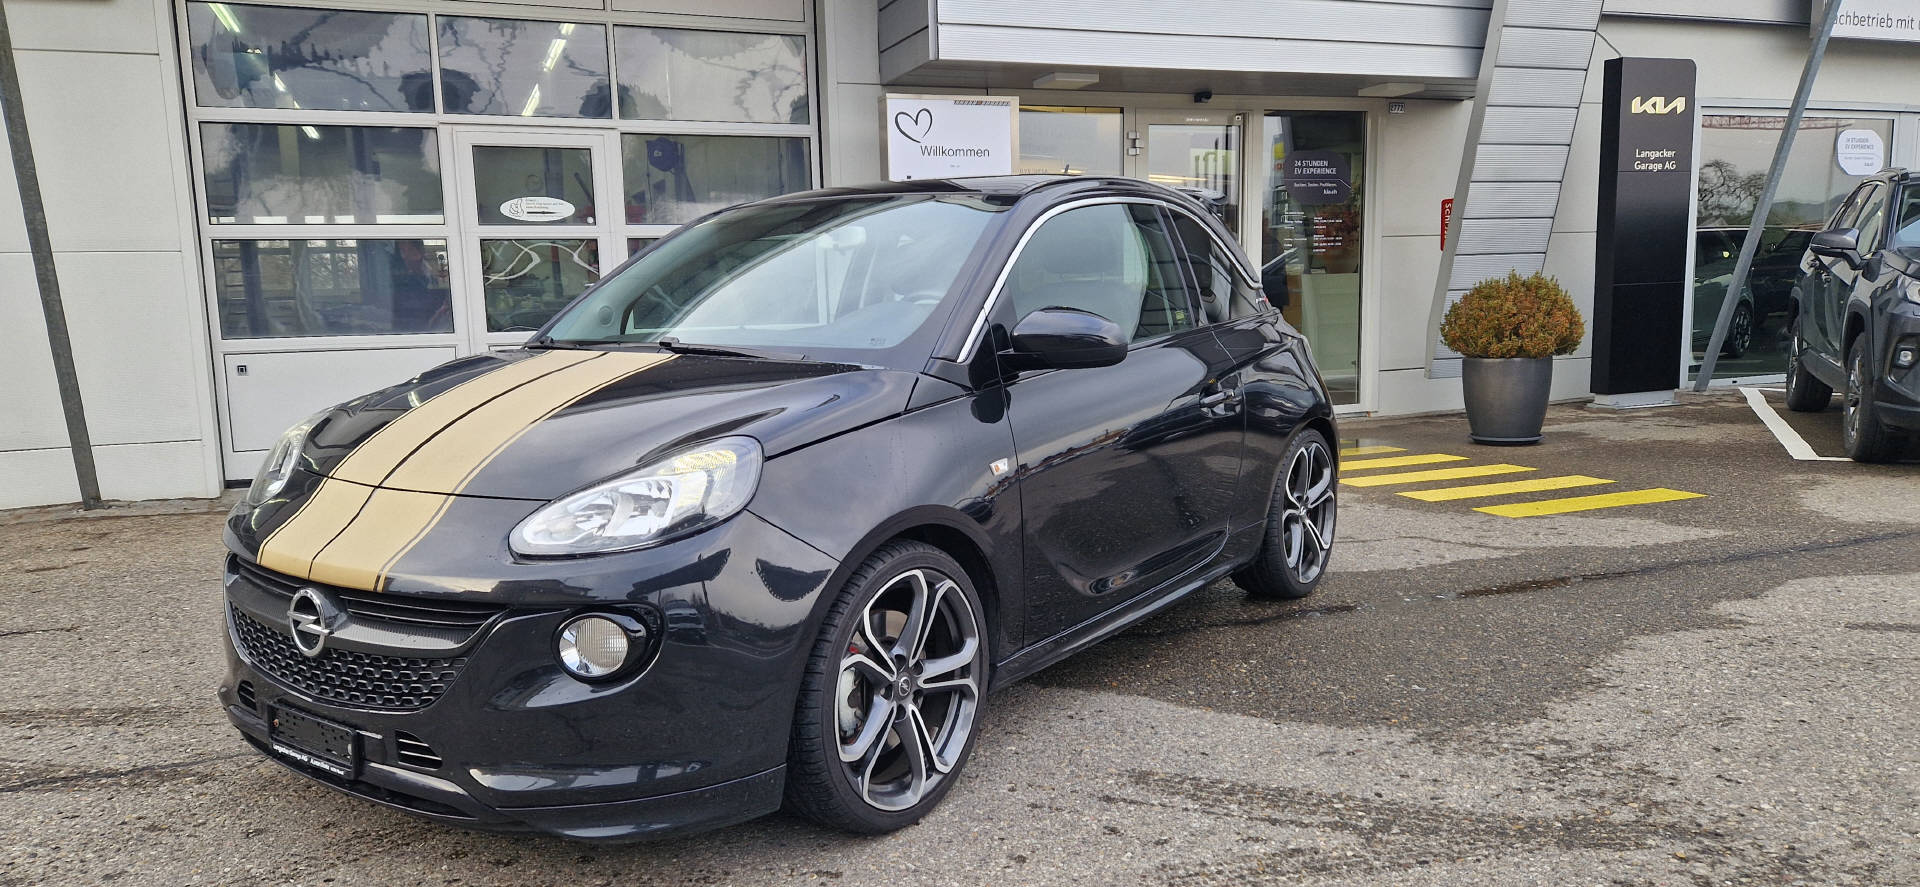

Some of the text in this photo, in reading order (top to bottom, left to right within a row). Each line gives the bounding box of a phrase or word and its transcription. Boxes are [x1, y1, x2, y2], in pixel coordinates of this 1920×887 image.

[1896, 16, 1914, 30] mit
[1631, 96, 1686, 114] KIA
[920, 145, 990, 157] Willkommen
[1635, 148, 1676, 160] Langacker
[1634, 161, 1676, 172] Garage AG
